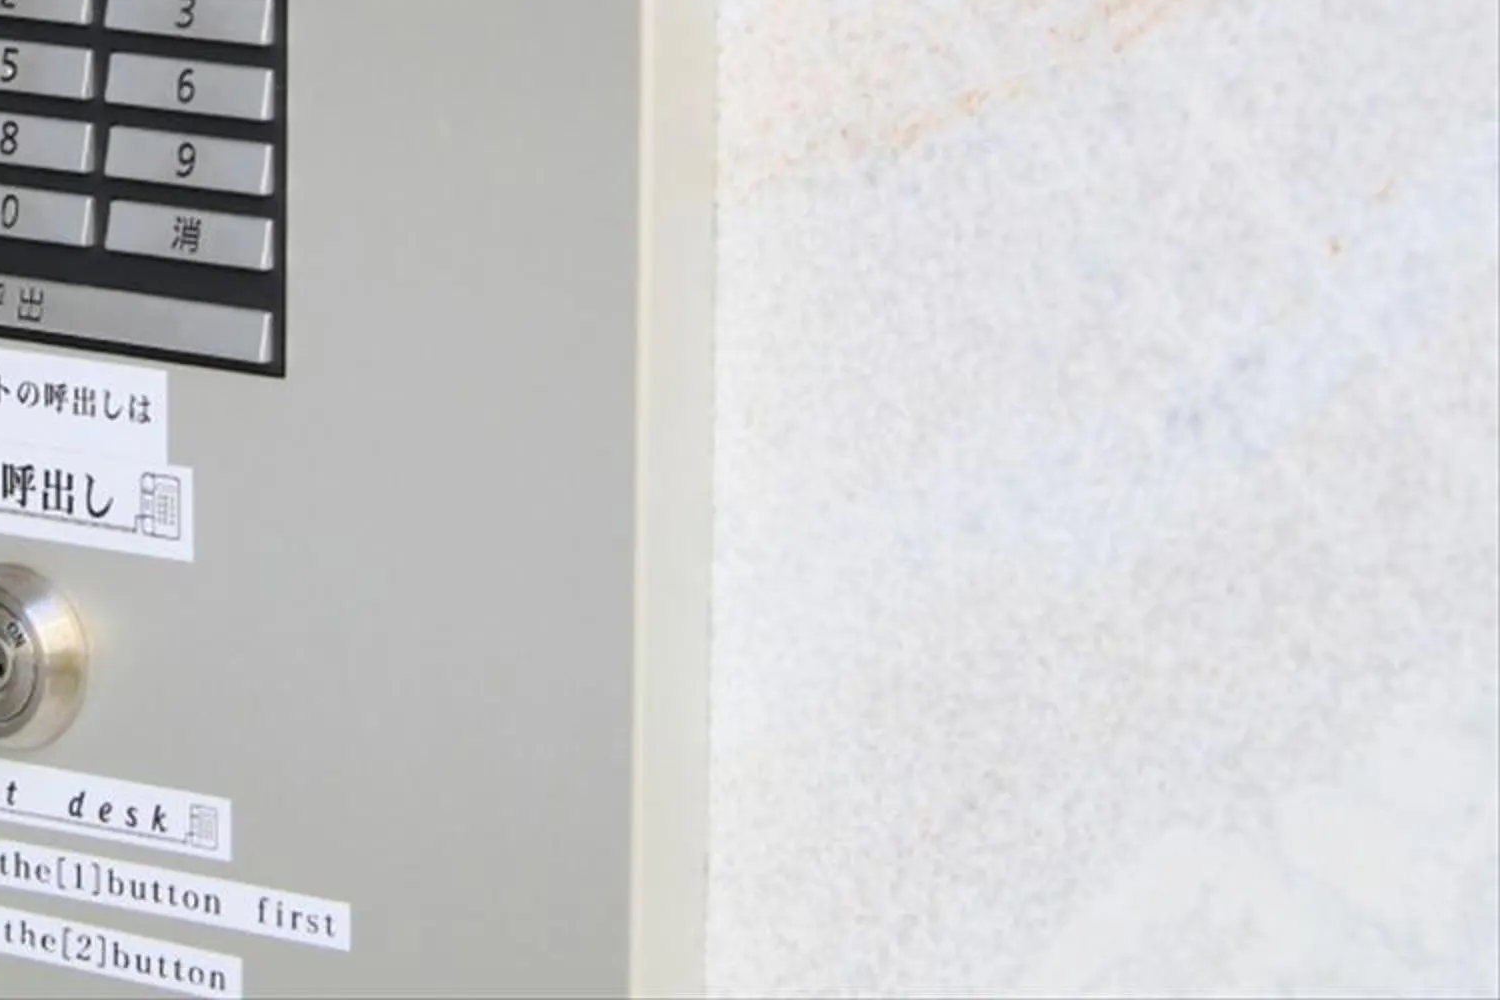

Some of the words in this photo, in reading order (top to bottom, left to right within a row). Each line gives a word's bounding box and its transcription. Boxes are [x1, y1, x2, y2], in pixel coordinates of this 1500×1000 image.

[0, 46, 19, 83] 5
[176, 67, 196, 103] 6
[0, 120, 19, 156] 8
[176, 142, 196, 178] 9
[0, 194, 19, 229] 0
[170, 215, 202, 255] 消
[68, 791, 171, 834] desk
[257, 895, 338, 938] first
